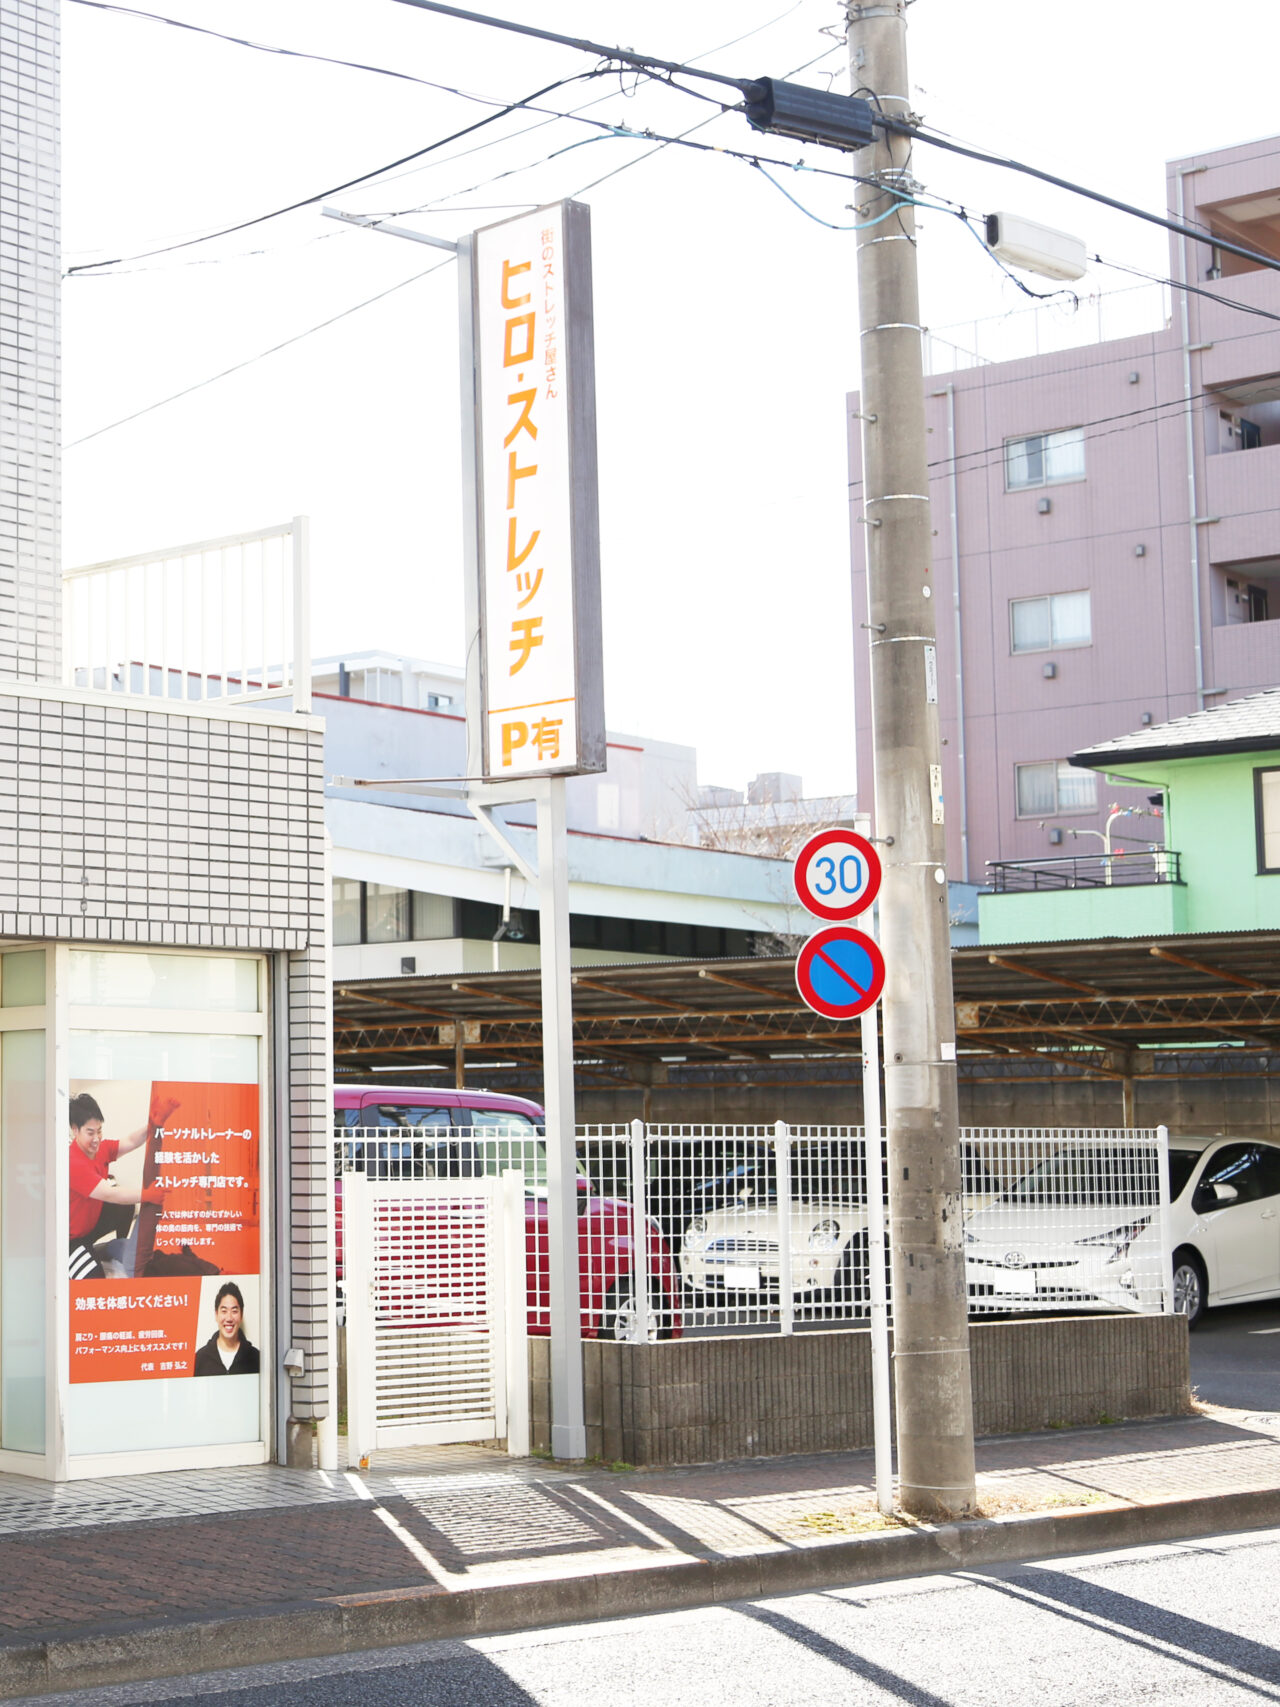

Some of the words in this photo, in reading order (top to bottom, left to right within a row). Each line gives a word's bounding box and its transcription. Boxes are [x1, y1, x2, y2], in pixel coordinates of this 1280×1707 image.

[540, 227, 558, 400] 街のストレッチ屋さん
[500, 716, 564, 767] P有
[815, 854, 862, 895] 30
[154, 1127, 252, 1140] パーソナルトレーナーの
[154, 1151, 220, 1164] 経験を活かした
[154, 1176, 249, 1188] ストレッチ専門店です。
